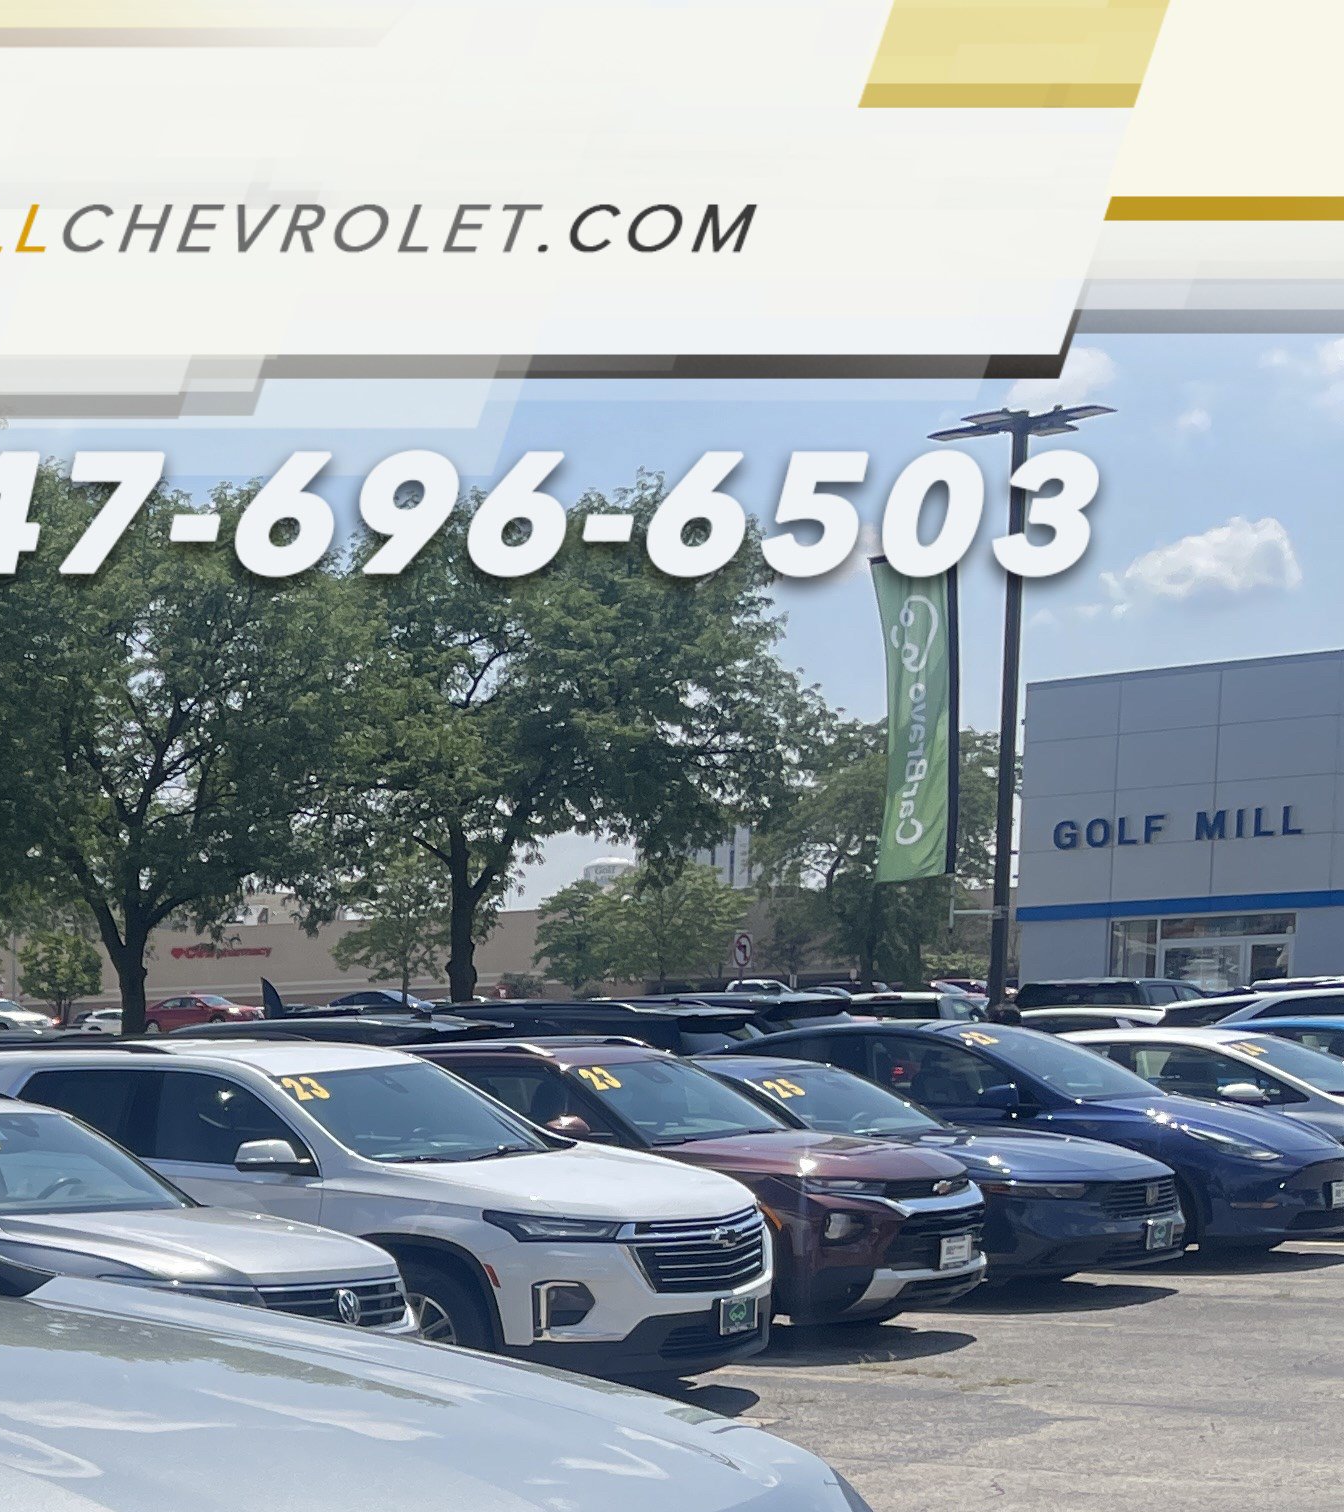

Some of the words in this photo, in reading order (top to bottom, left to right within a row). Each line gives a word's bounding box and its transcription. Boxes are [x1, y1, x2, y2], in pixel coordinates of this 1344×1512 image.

[1053, 814, 1166, 850] GOLF
[1195, 805, 1305, 841] MILL
[280, 1076, 331, 1101] 23
